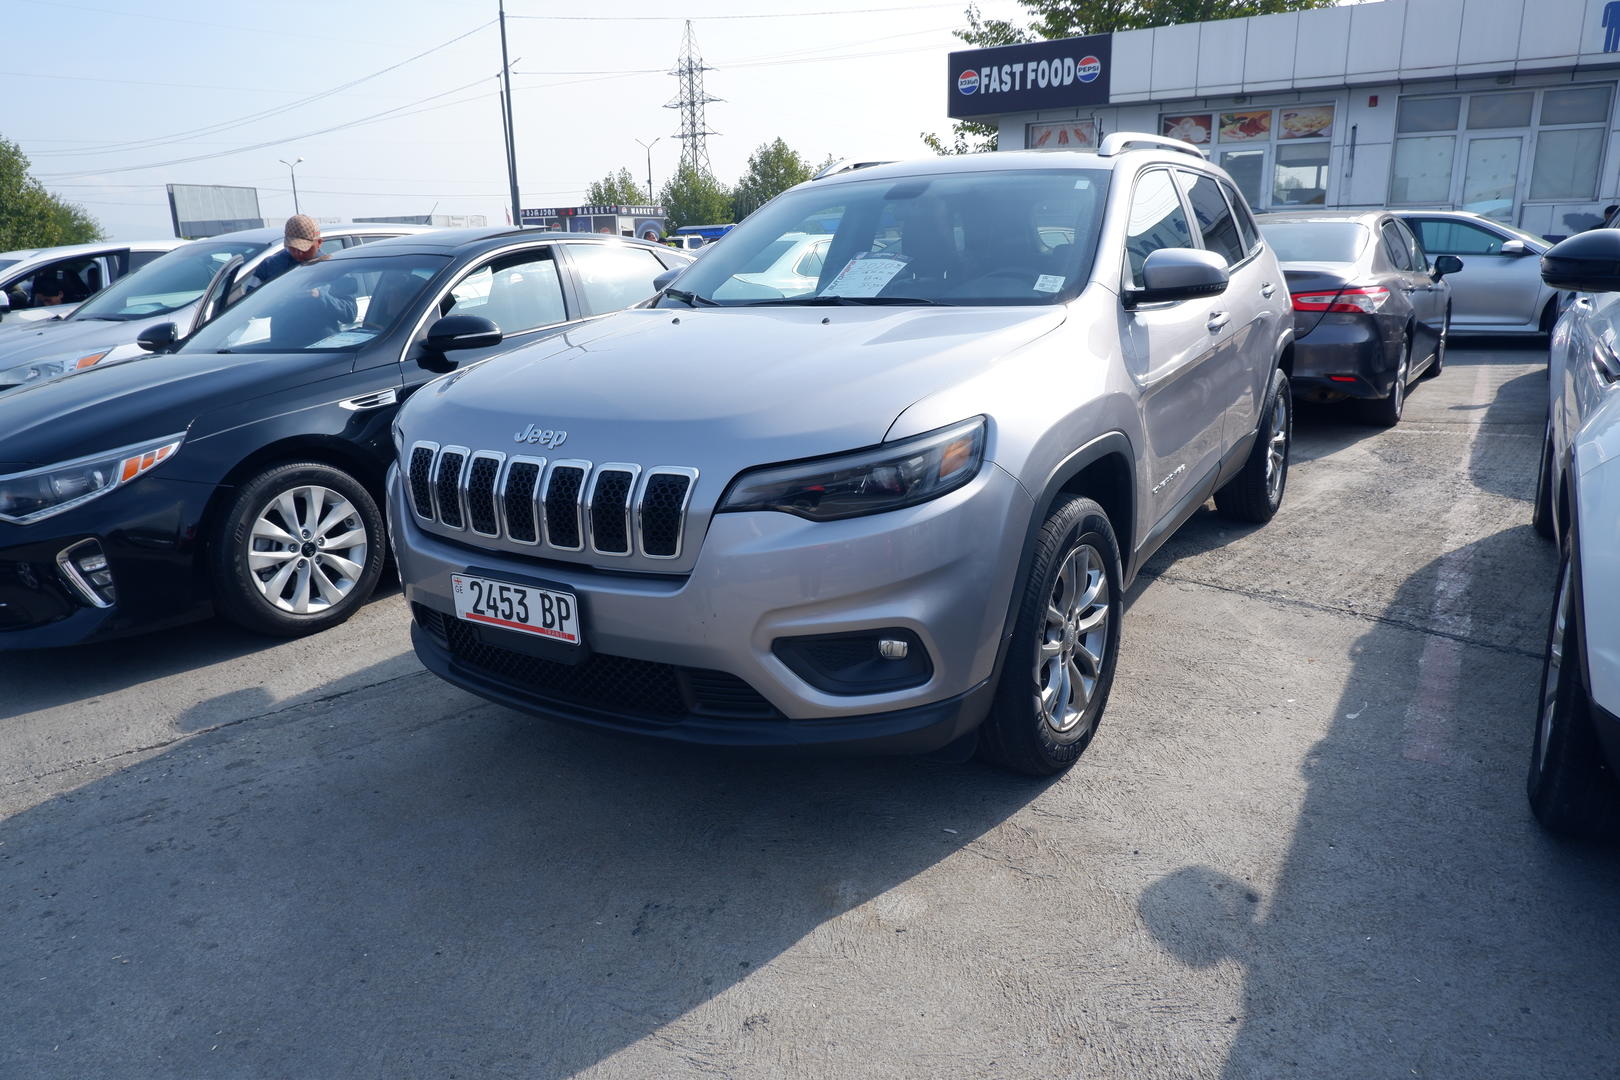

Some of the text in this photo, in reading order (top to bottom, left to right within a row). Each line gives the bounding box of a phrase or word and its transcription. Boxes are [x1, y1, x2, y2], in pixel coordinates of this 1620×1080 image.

[980, 57, 1075, 94] FAST FOOD
[1077, 65, 1100, 74] PEPSI
[576, 206, 610, 216] MARKET
[630, 208, 655, 216] MARKET
[513, 423, 568, 450] Jeep
[469, 581, 571, 631] 2453 BP
